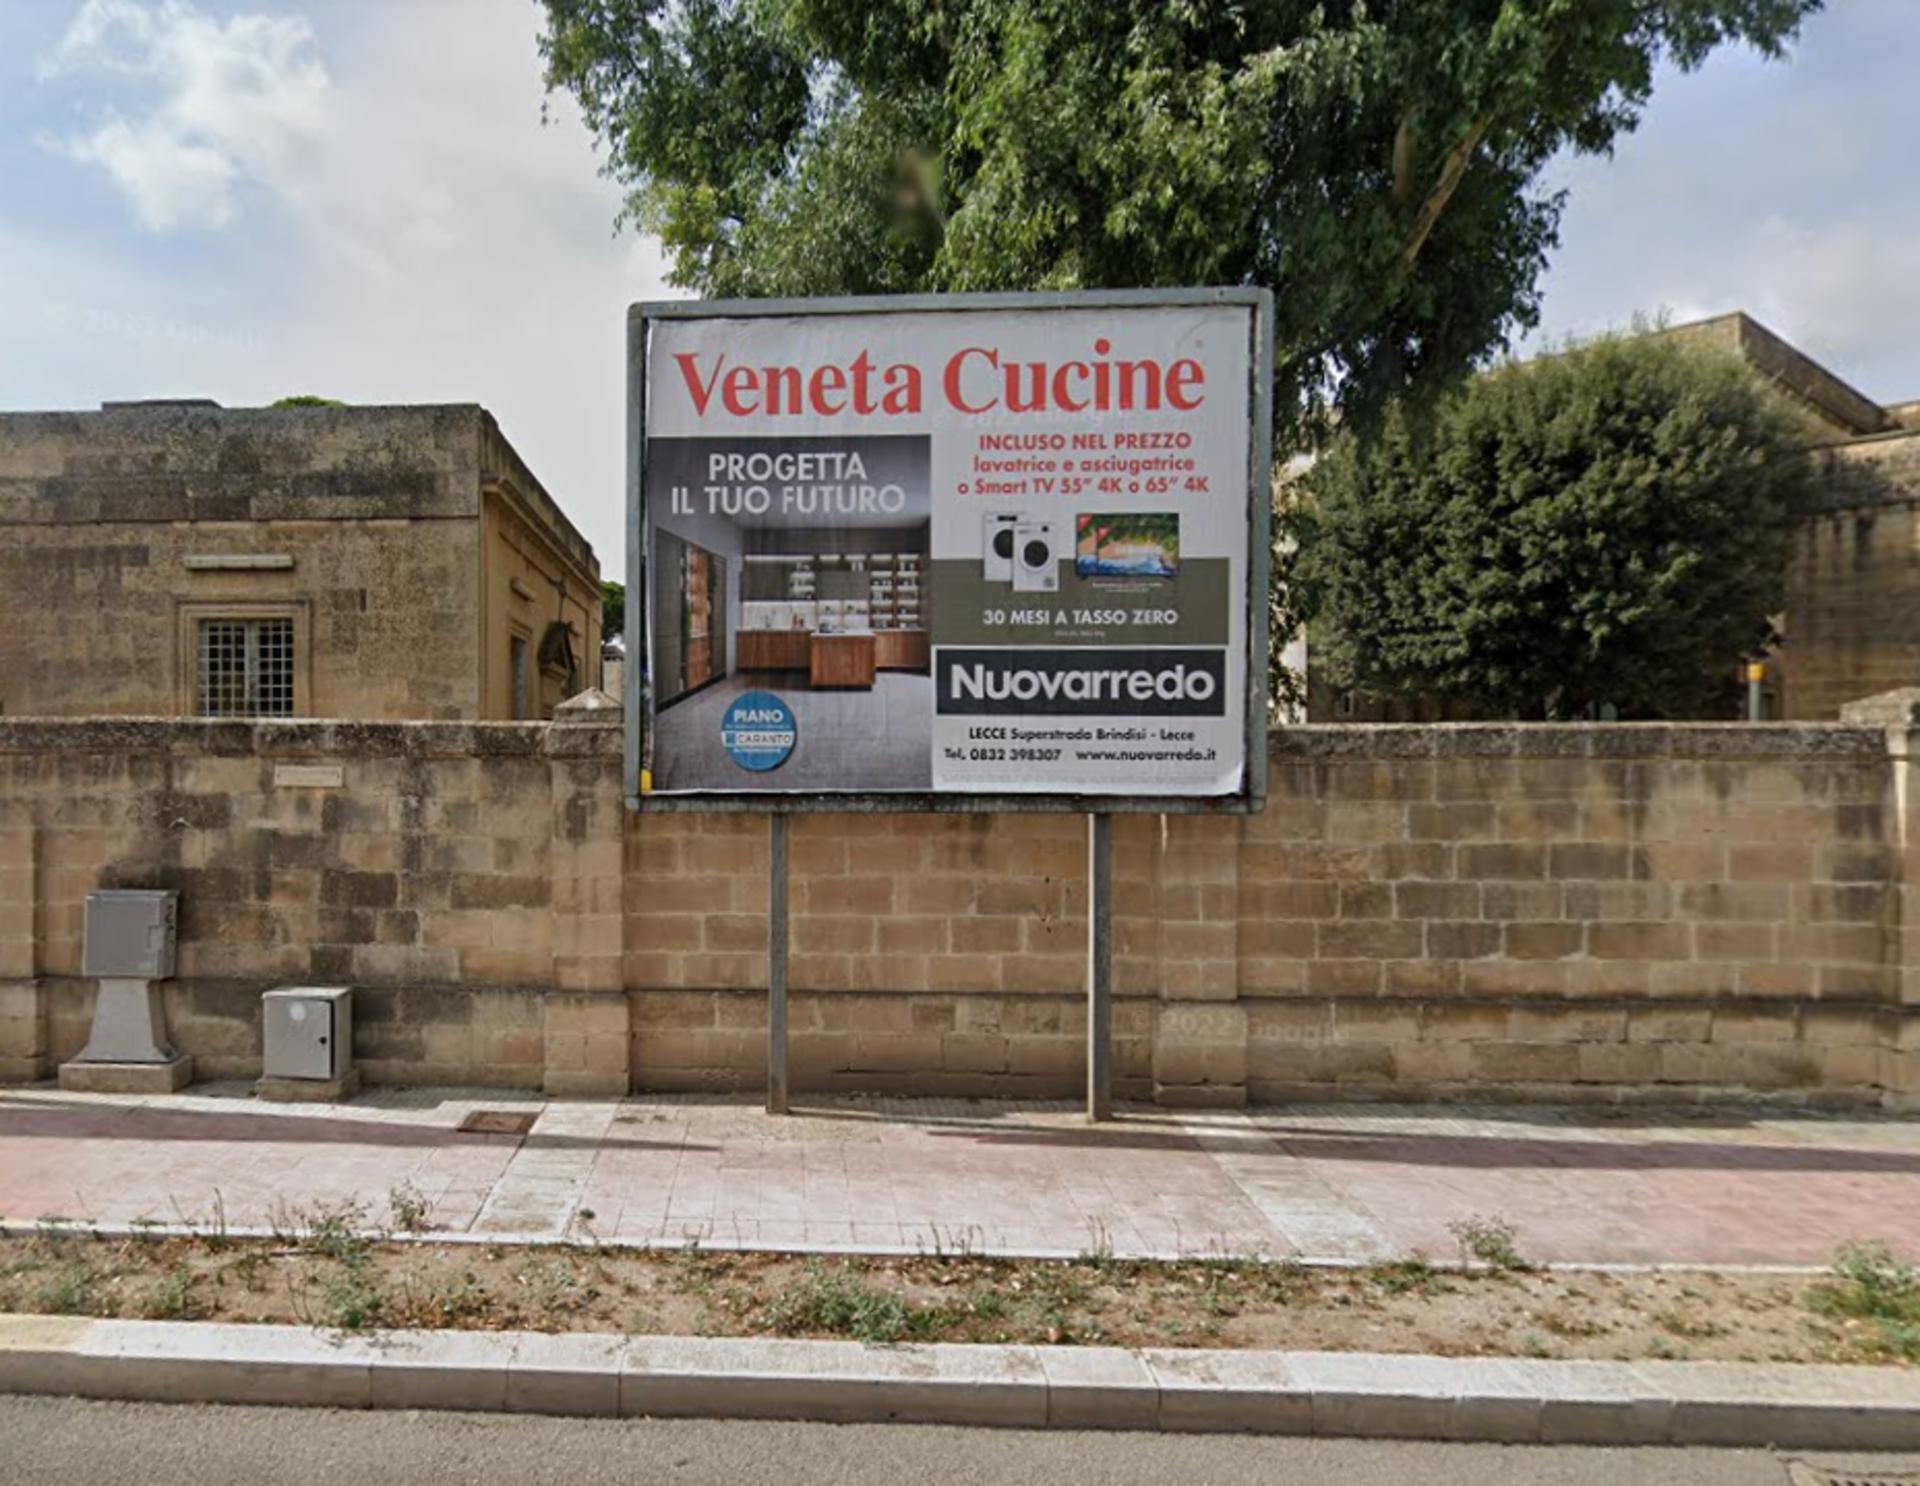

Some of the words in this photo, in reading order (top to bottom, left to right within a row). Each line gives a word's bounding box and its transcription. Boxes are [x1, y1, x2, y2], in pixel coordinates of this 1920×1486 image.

[672, 349, 922, 417] Veneta
[943, 338, 1206, 415] Cucine
[979, 434, 1066, 451] INCLUSO
[1072, 434, 1108, 449] NEL
[1114, 432, 1192, 449] PREZZO
[708, 452, 868, 481] PROGETTA
[973, 455, 1057, 472] lavatrice
[1062, 459, 1074, 472] e
[1080, 454, 1196, 475] asciugatrice
[957, 482, 969, 495] o
[975, 479, 1027, 494] Smart
[1032, 478, 1056, 494] TV
[1097, 477, 1122, 493] 4K
[1129, 481, 1140, 494] o
[1183, 476, 1209, 492] 4K
[671, 486, 695, 514] IL
[704, 485, 771, 514] TUO
[782, 484, 906, 514] FUTURO
[983, 610, 1005, 625] 30
[1010, 609, 1050, 625] MESI
[1054, 610, 1068, 625] A
[1072, 609, 1127, 625] TASSO
[1132, 609, 1179, 624] ZERO
[951, 663, 1215, 700] Nuovarredo
[734, 709, 784, 723] PIANO
[738, 734, 791, 744] CARANTO
[968, 727, 1006, 740] LECCE
[1011, 728, 1093, 742] Superstrada
[1097, 727, 1146, 740] Brindisi
[1160, 729, 1195, 741] Lecce
[944, 748, 966, 760] Tel.
[969, 748, 1005, 761] 0832
[1075, 747, 1217, 762] www.nuovarredo.it
